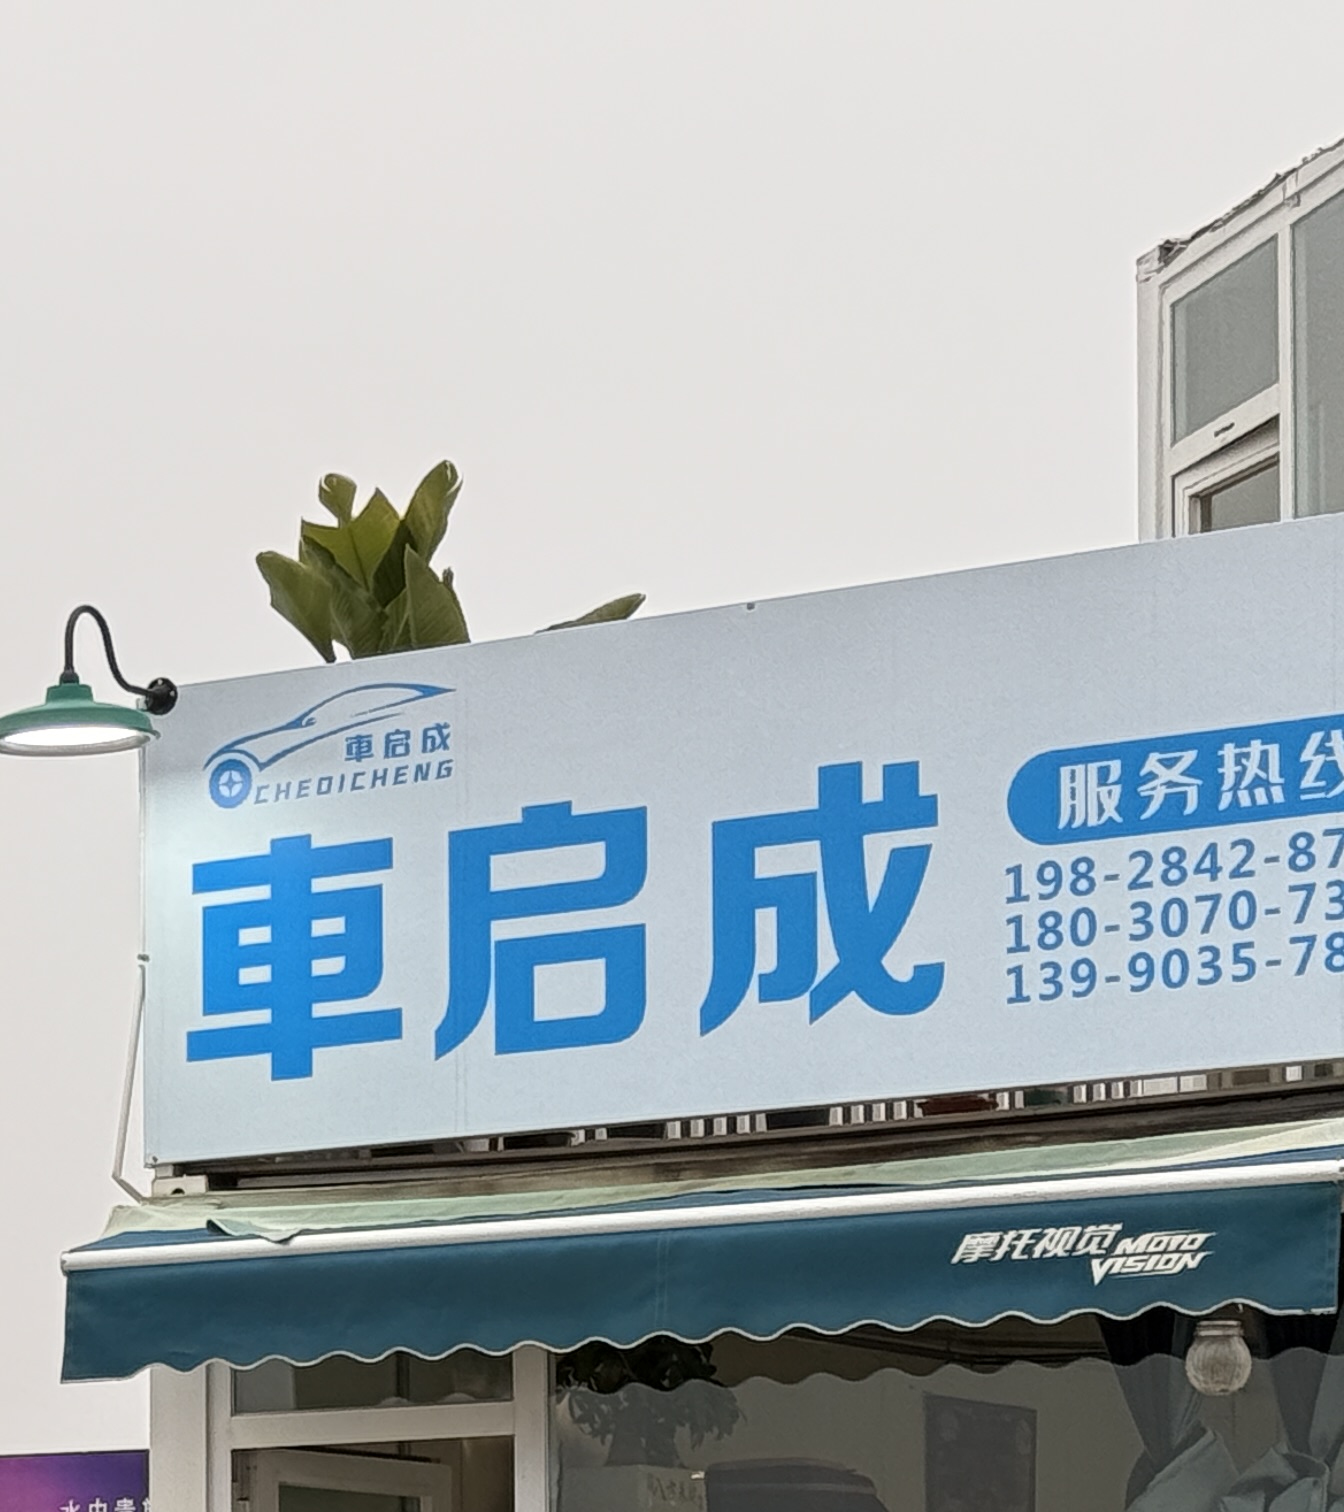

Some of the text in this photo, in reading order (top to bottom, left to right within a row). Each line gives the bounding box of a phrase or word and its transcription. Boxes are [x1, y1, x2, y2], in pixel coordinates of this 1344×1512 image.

[344, 721, 450, 762] 車启成
[1058, 729, 1344, 829] 服务热线
[1006, 827, 1344, 904] 198-2842-87
[186, 761, 944, 1080] 車启成
[1006, 879, 1344, 954] 180-3070-73
[1007, 931, 1344, 1005] 139-9035-78
[950, 1222, 1123, 1265] 摩托视觉
[1091, 1251, 1212, 1287] VISION
